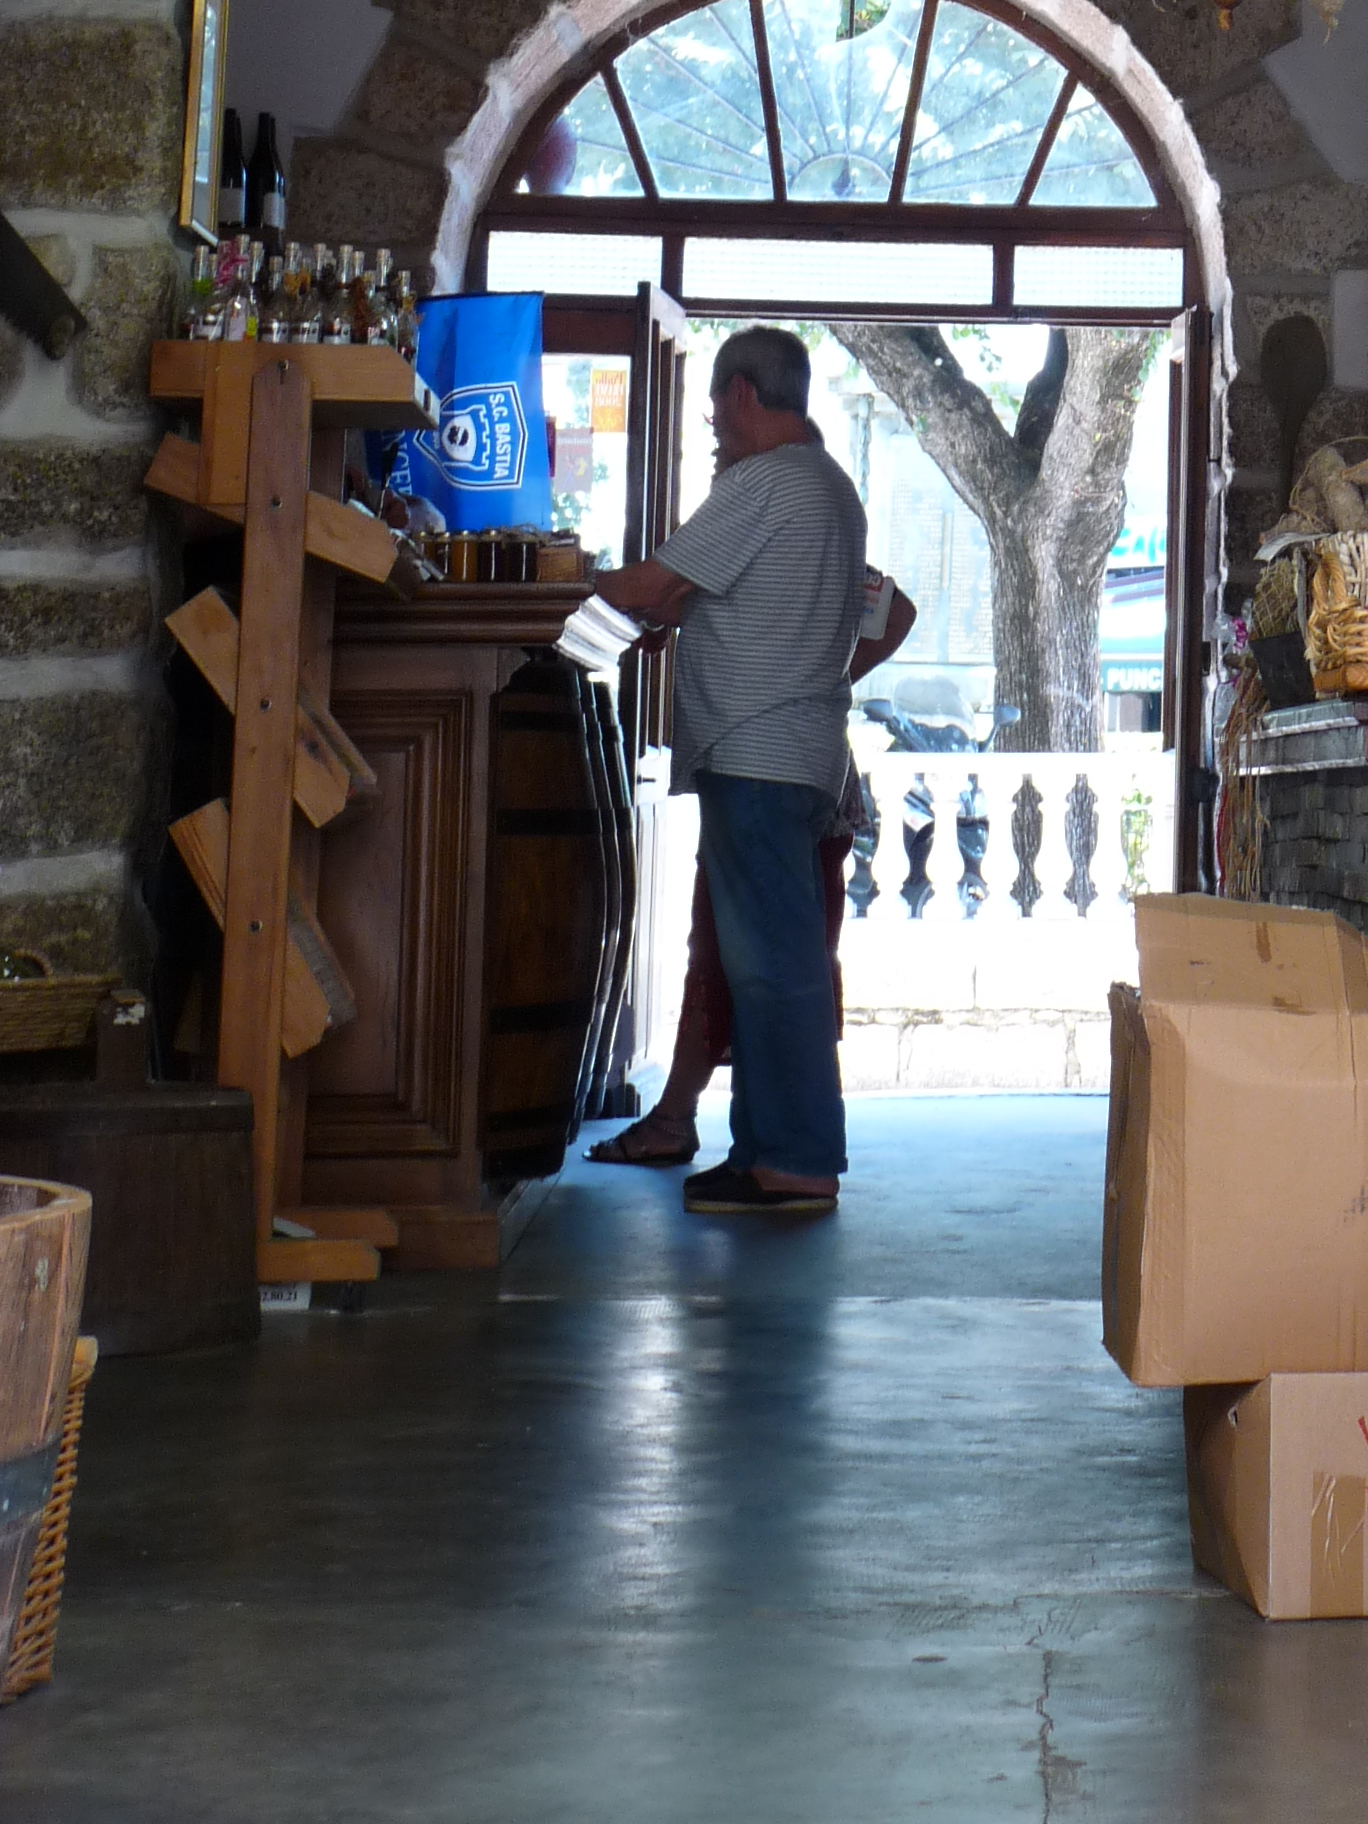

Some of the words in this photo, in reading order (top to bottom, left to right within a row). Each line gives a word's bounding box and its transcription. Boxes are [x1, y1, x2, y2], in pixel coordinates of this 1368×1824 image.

[489, 393, 508, 421] S.C.
[493, 423, 512, 479] BASTIA
[1107, 667, 1163, 691] PUNC
